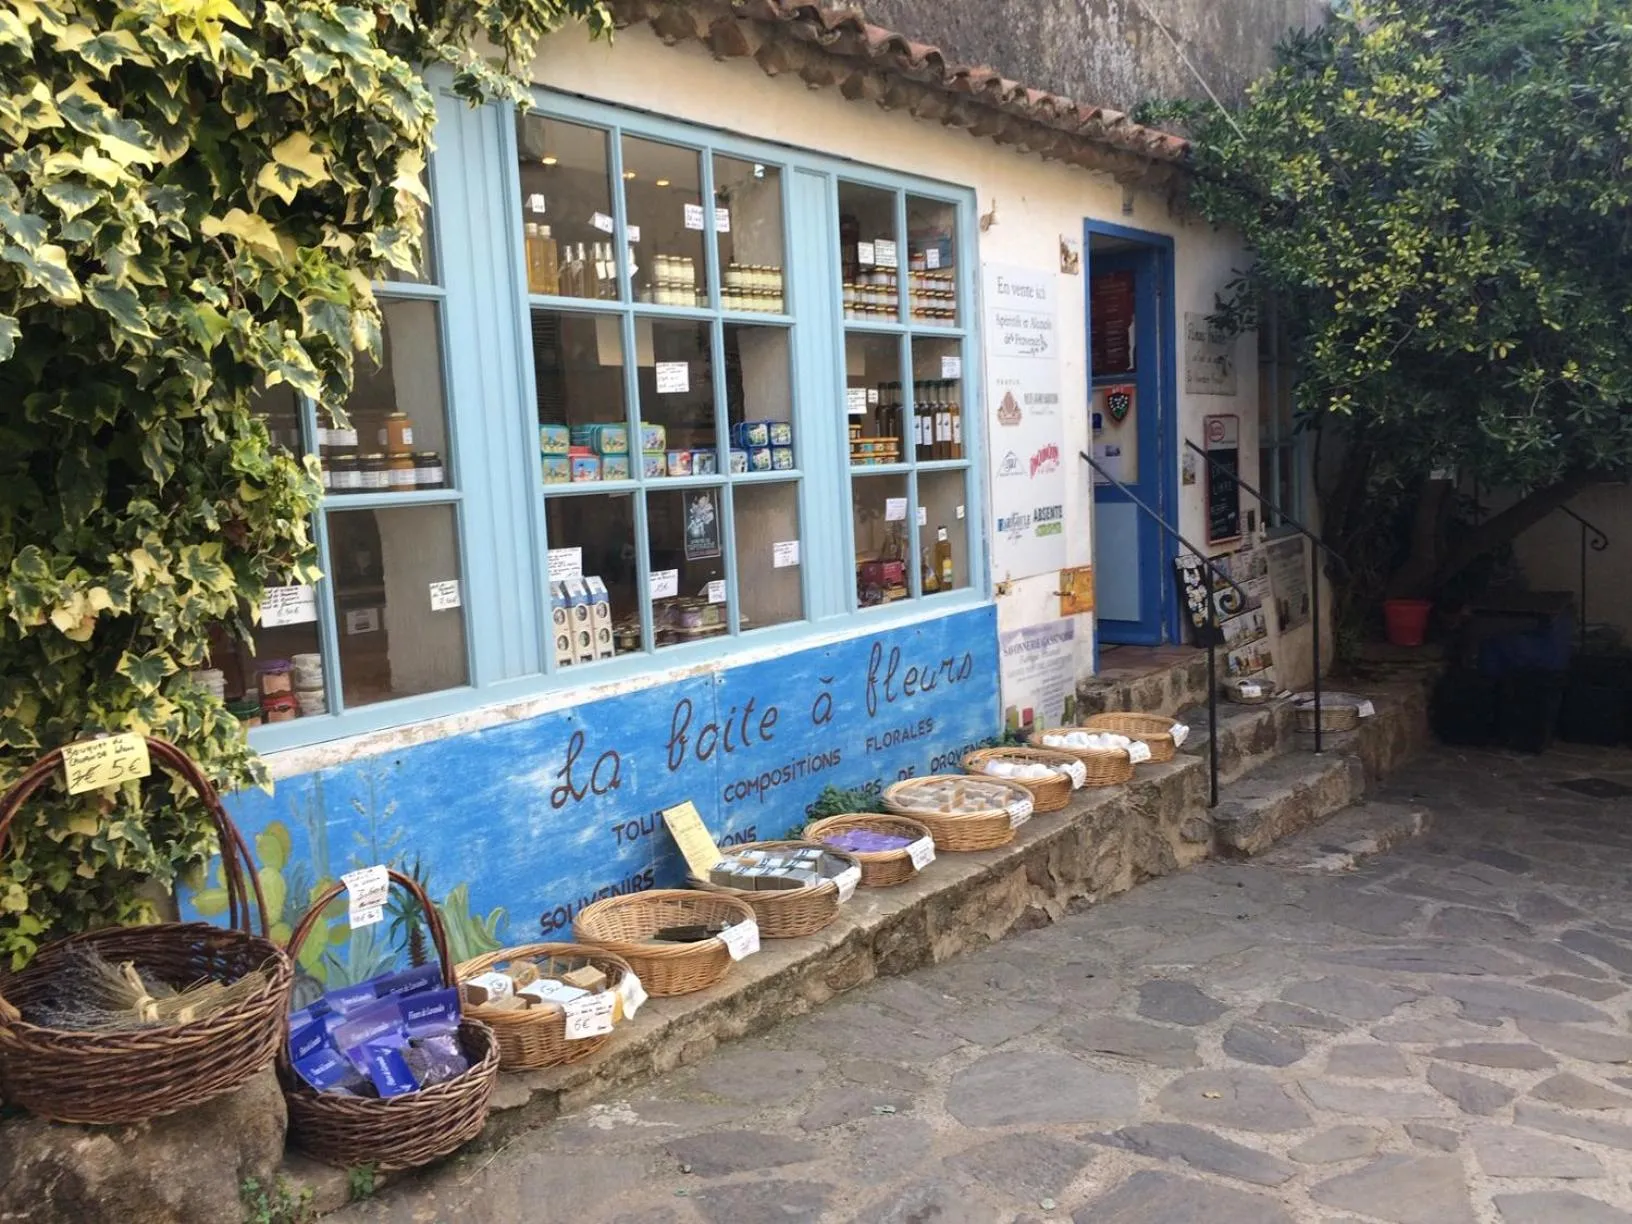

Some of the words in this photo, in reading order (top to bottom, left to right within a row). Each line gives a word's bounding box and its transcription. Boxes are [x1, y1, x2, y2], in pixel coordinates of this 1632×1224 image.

[551, 730, 622, 809] La
[665, 697, 778, 771] boite
[866, 640, 973, 718] fleurs
[723, 747, 842, 803] COMPOSITIONS
[866, 717, 934, 755] FLORALES
[896, 765, 916, 782] DE
